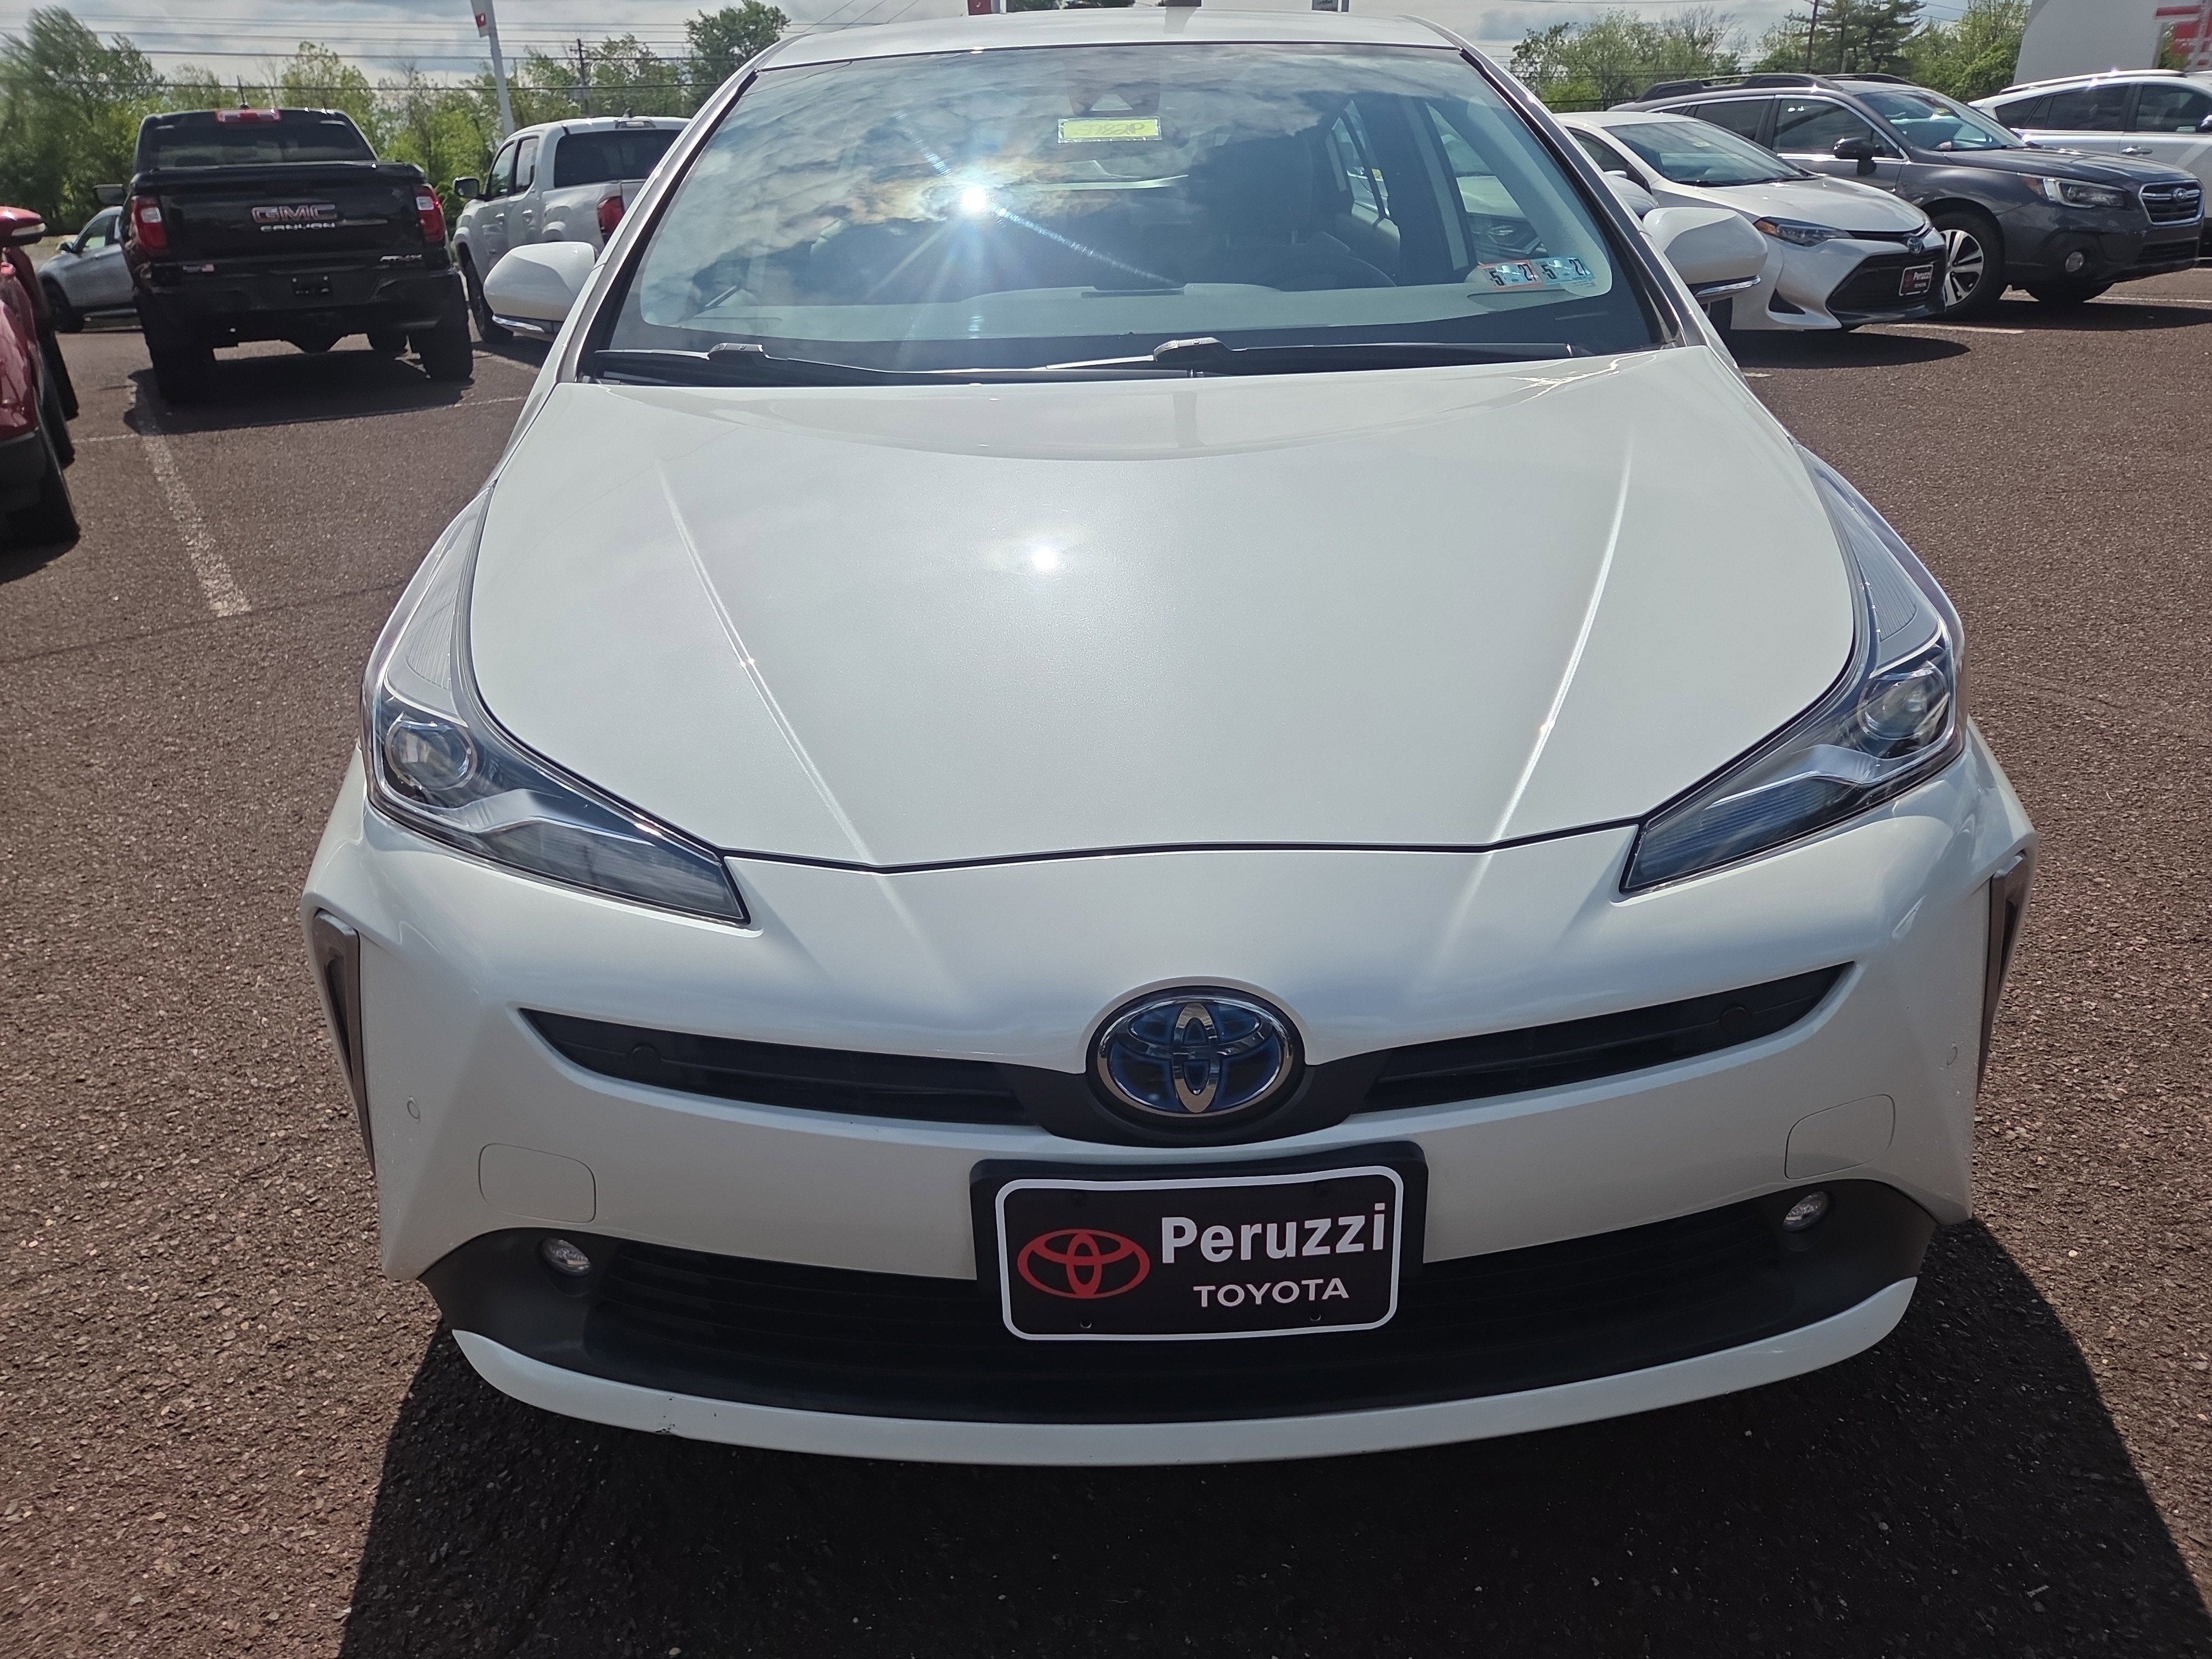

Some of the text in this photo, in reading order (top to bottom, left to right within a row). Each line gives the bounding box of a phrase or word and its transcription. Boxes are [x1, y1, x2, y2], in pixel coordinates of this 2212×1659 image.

[252, 204, 337, 223] GMC
[1489, 264, 1537, 286] 5 27
[1541, 259, 1588, 280] 5 27
[1161, 1203, 1386, 1264] Peruzzi
[1193, 1278, 1349, 1307] TOYOTA
